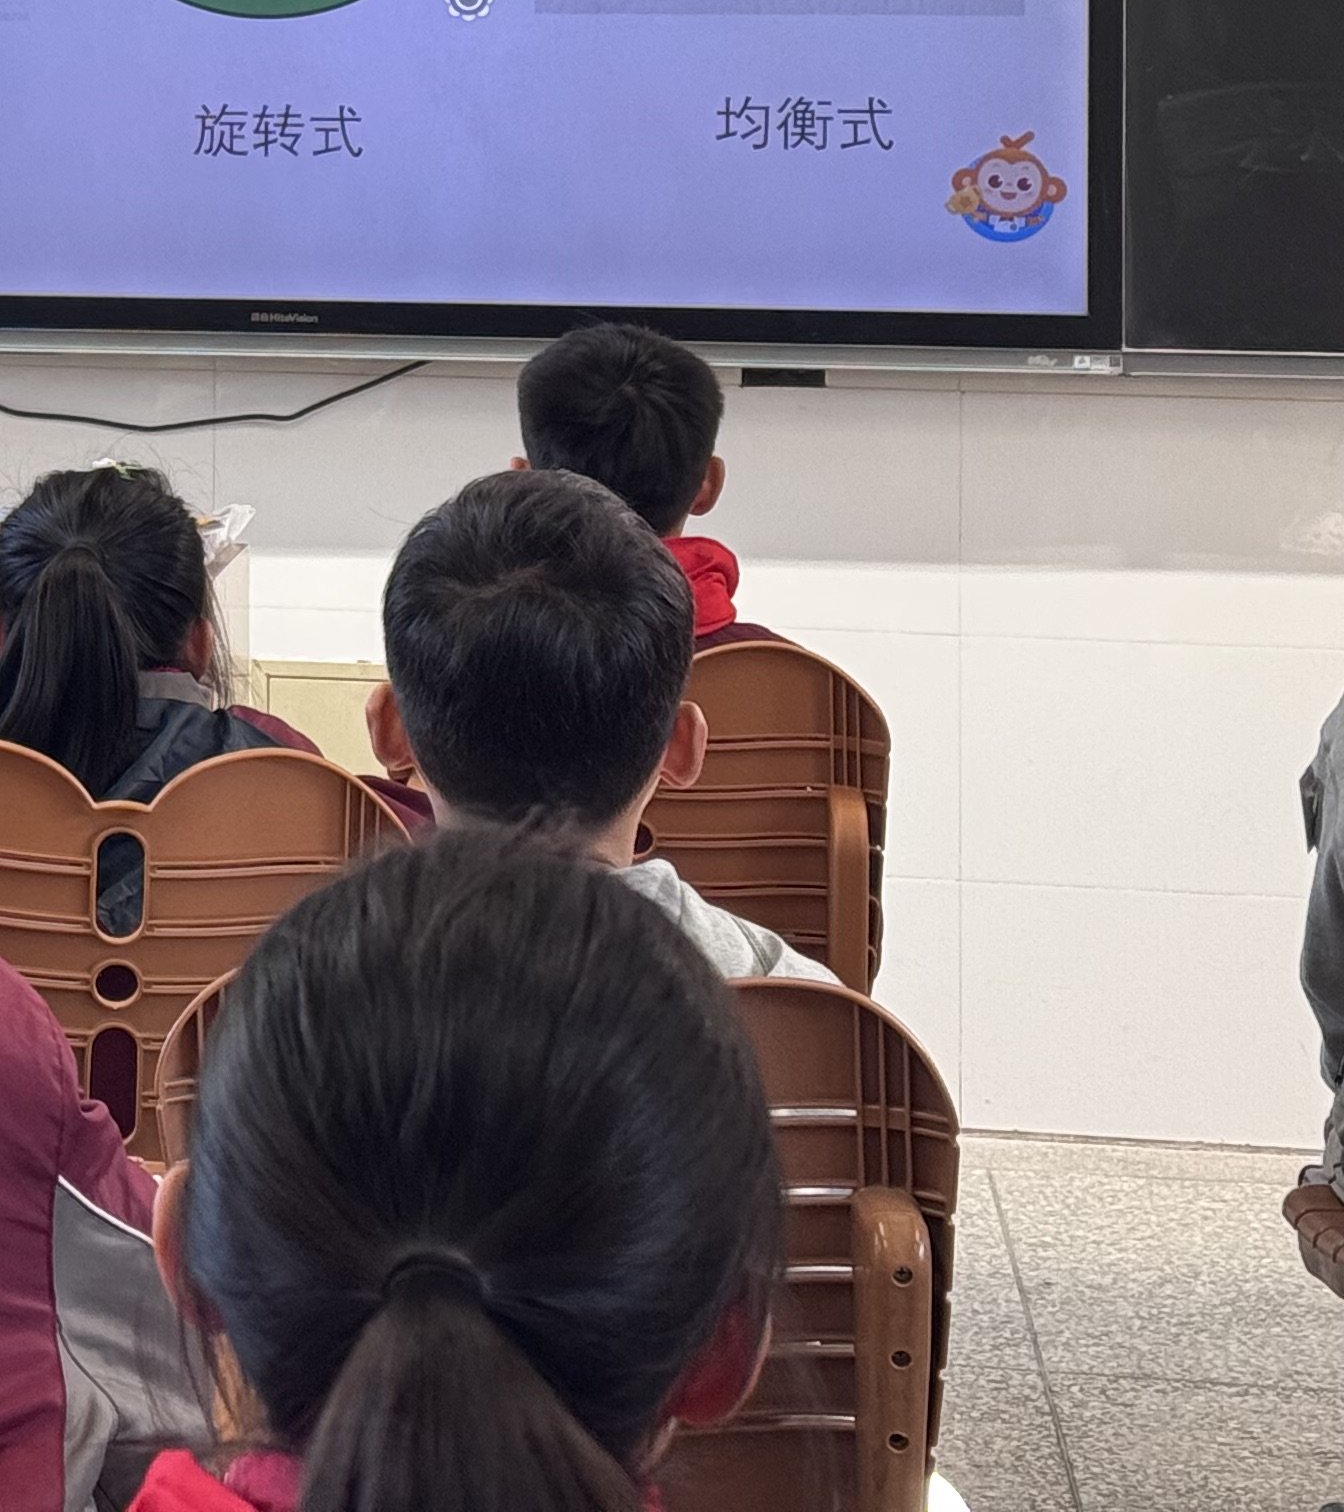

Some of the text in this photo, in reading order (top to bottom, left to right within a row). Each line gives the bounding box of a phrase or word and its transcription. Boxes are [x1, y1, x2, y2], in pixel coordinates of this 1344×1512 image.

[193, 103, 364, 158] 旋转式
[715, 95, 895, 151] 均衡式
